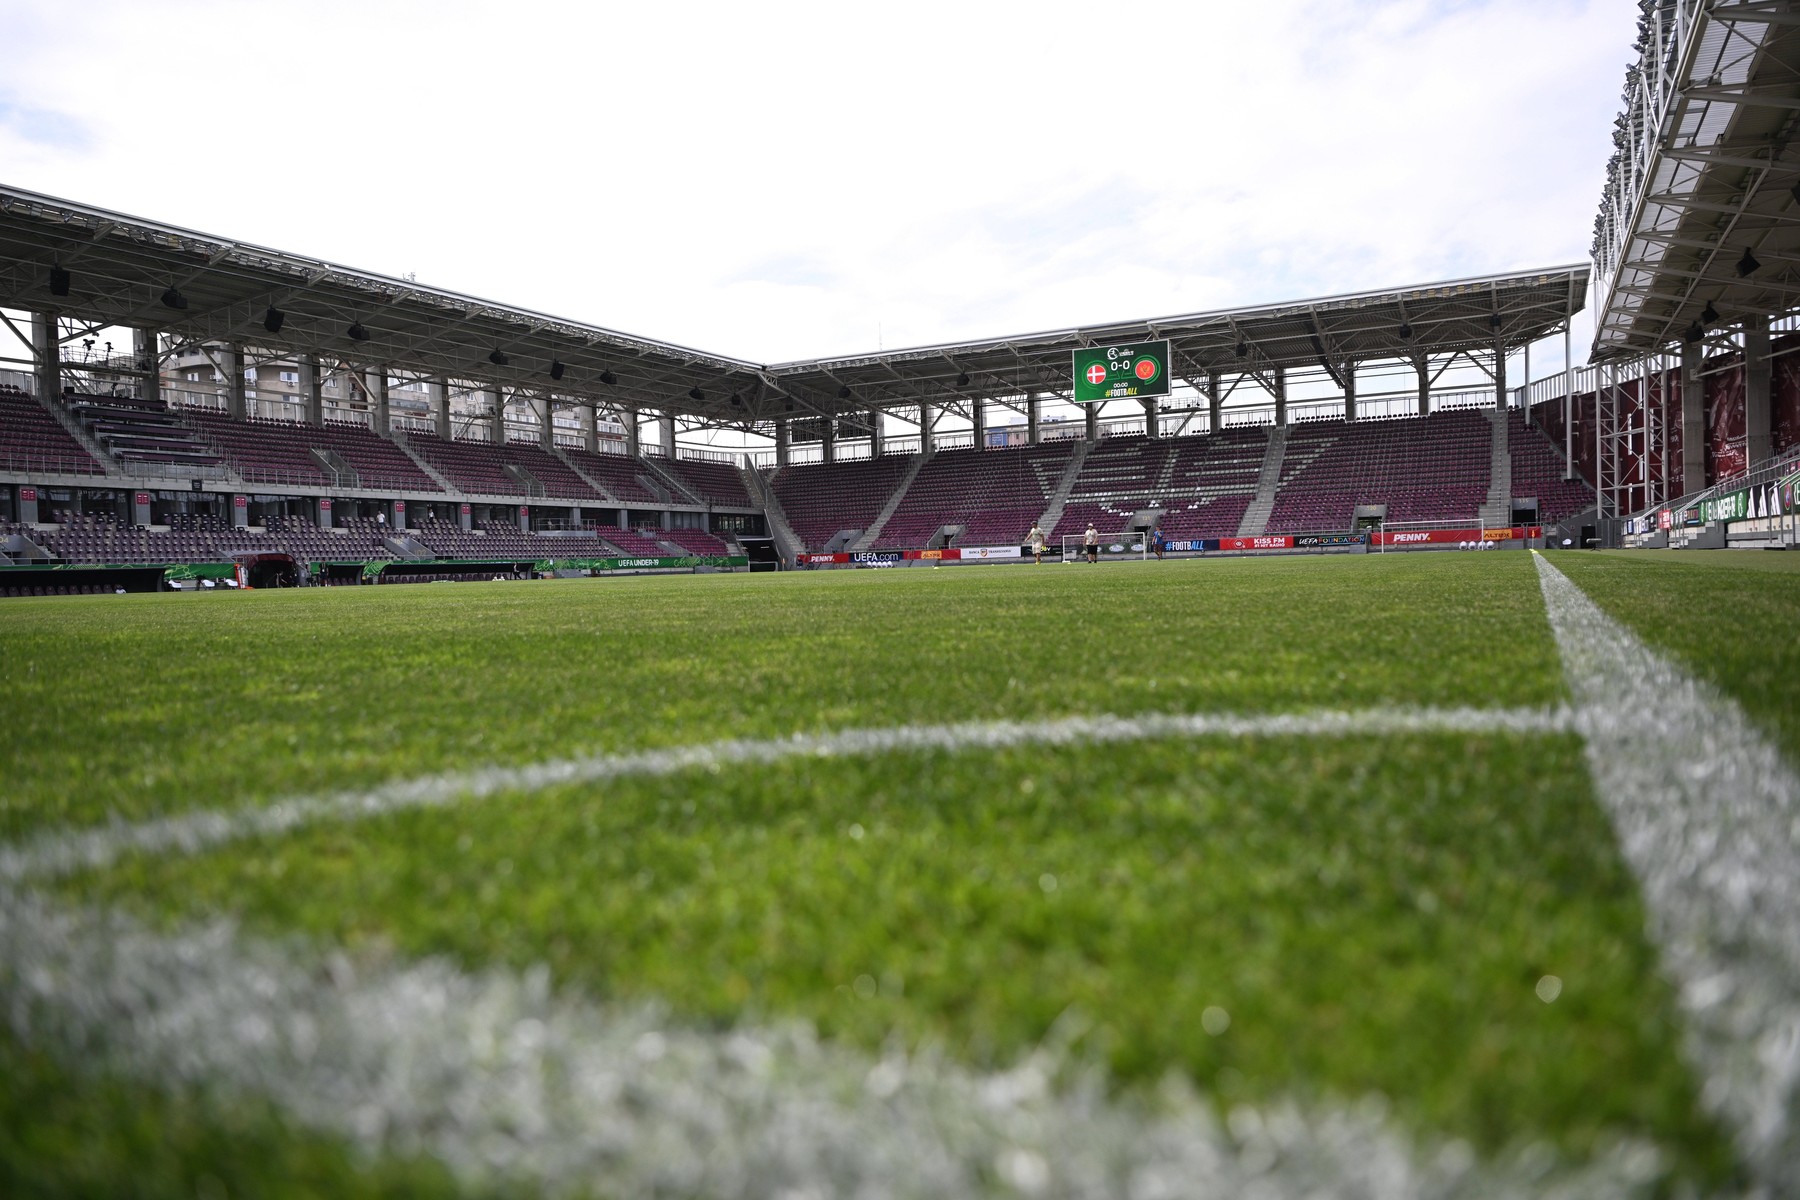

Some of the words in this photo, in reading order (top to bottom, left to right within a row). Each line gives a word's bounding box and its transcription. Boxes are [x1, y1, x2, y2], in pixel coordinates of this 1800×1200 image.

[1298, 537, 1318, 545] UEFA
[1318, 535, 1365, 544] FOUNDATION
[1165, 541, 1204, 551] #FOOTBALL
[853, 552, 899, 562] UEFA.com
[618, 559, 633, 567] UEFA
[634, 558, 660, 566] UNDER-19
